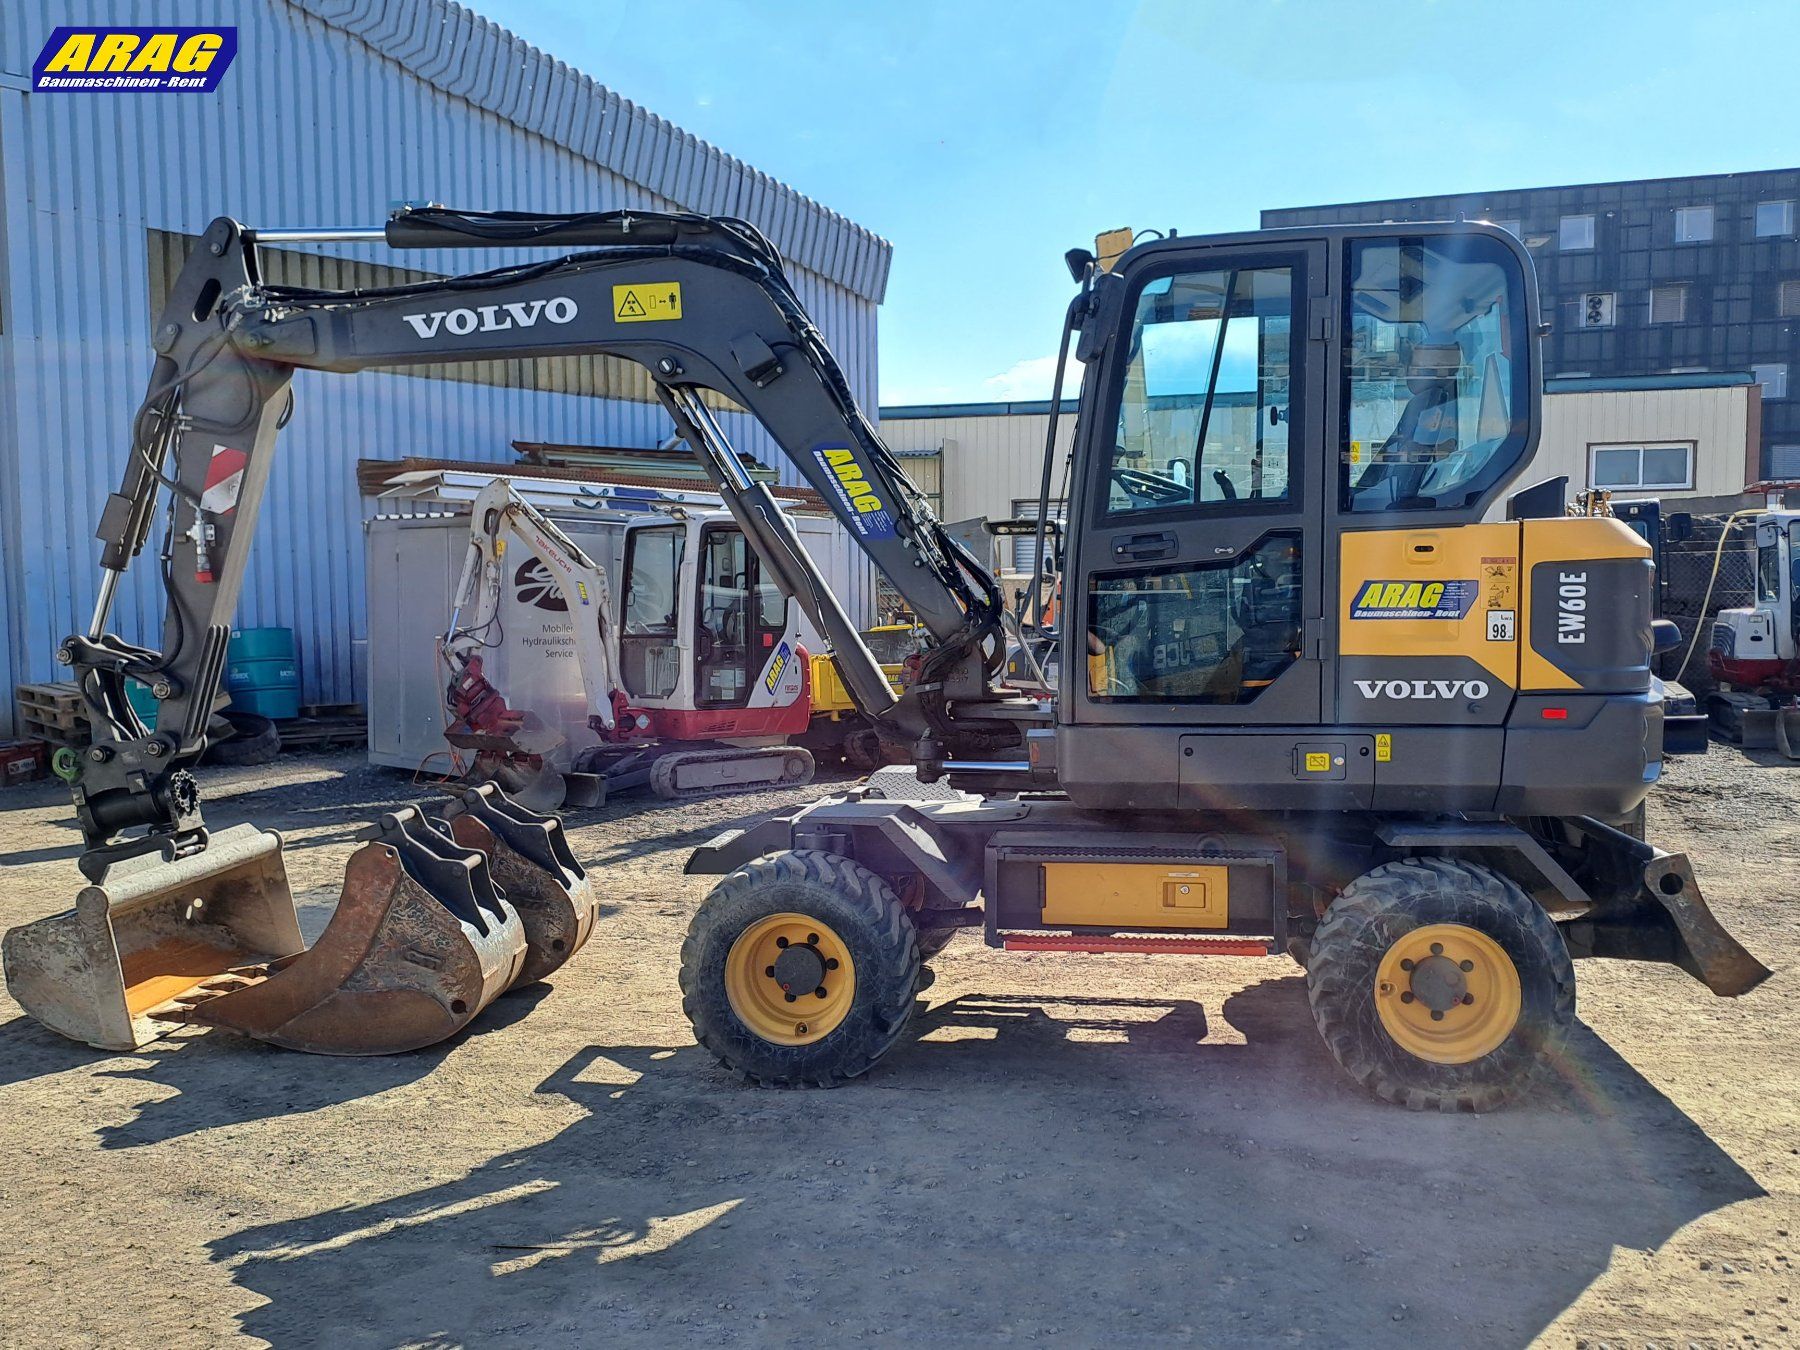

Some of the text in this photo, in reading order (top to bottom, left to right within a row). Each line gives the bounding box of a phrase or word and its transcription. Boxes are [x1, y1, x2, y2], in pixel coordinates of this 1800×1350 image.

[403, 297, 578, 339] VOLVO
[822, 449, 882, 513] ARAG
[1357, 583, 1445, 608] ARAG
[1558, 572, 1587, 644] EW60E
[542, 624, 573, 633] Mobiler
[1492, 623, 1507, 639] 98
[545, 649, 574, 658] Service
[766, 655, 785, 690] ARAG
[1353, 680, 1489, 700] VOLVO
